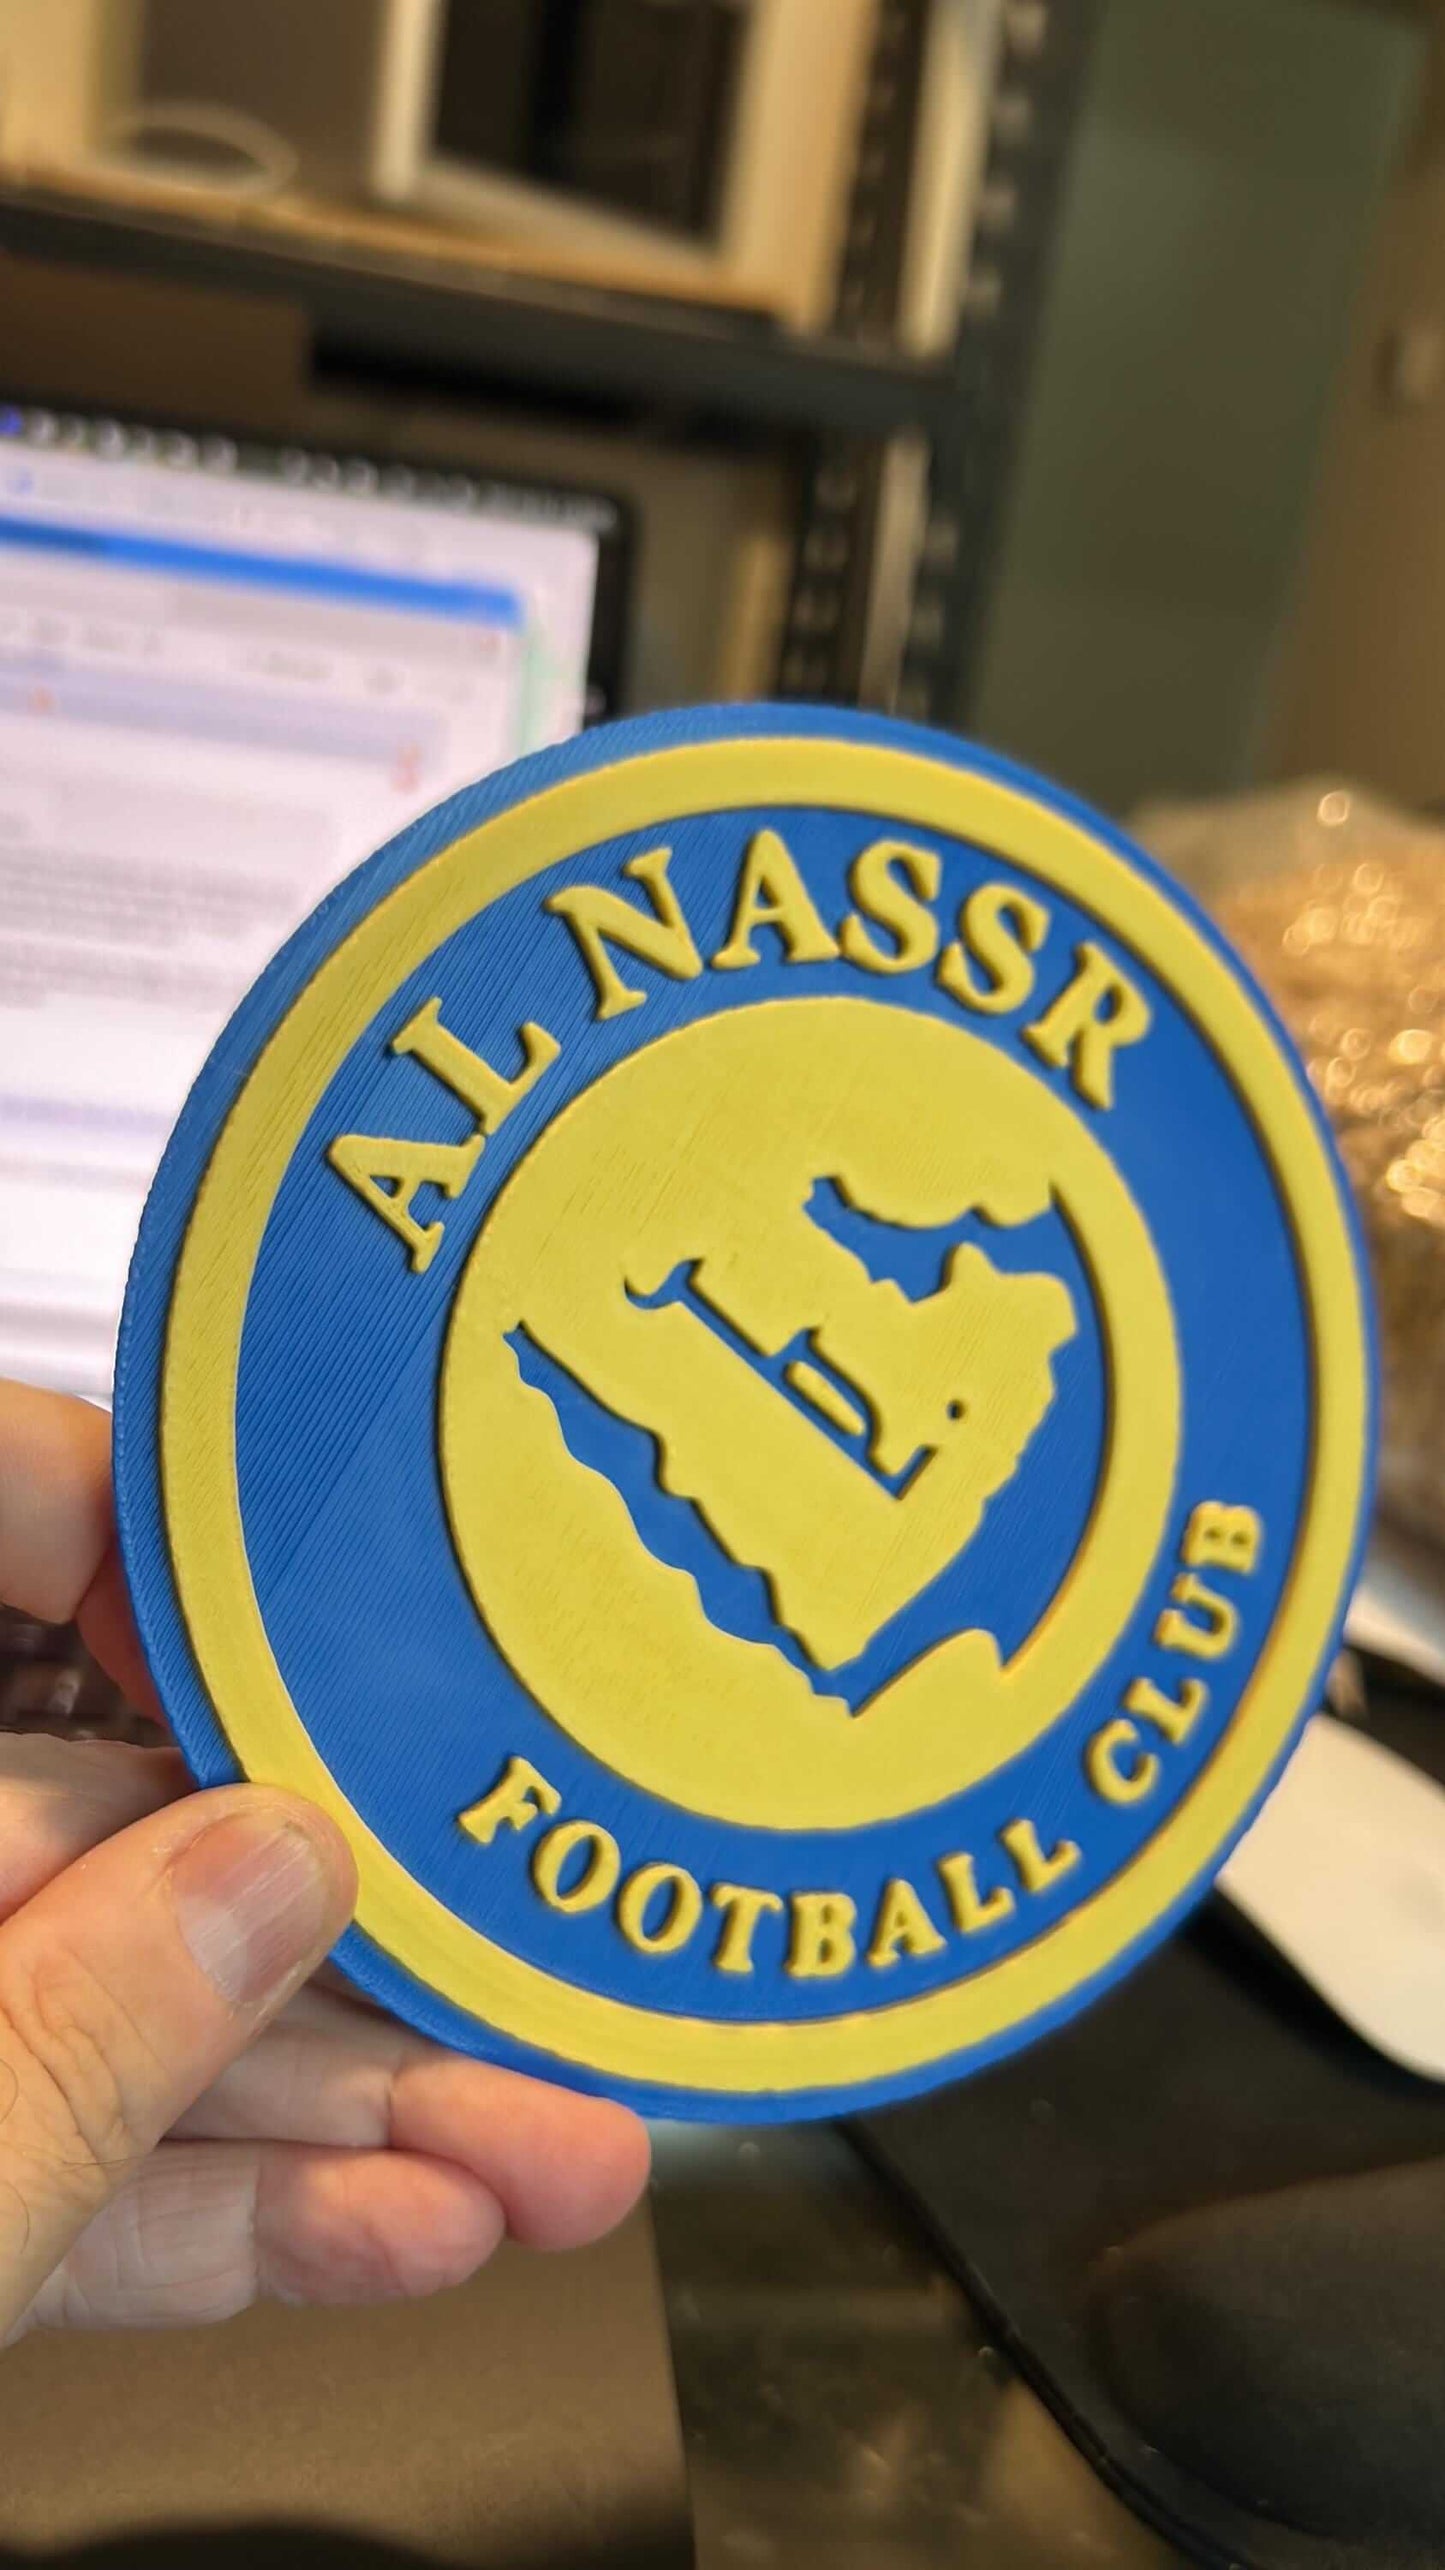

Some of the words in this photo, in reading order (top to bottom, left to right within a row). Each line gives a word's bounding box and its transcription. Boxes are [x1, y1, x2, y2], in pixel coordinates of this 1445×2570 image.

[329, 998, 560, 1272] AL
[547, 830, 1150, 1109] NASSR
[458, 1757, 1081, 1979] FOOTBALL
[1086, 1500, 1261, 1804] CLUB
